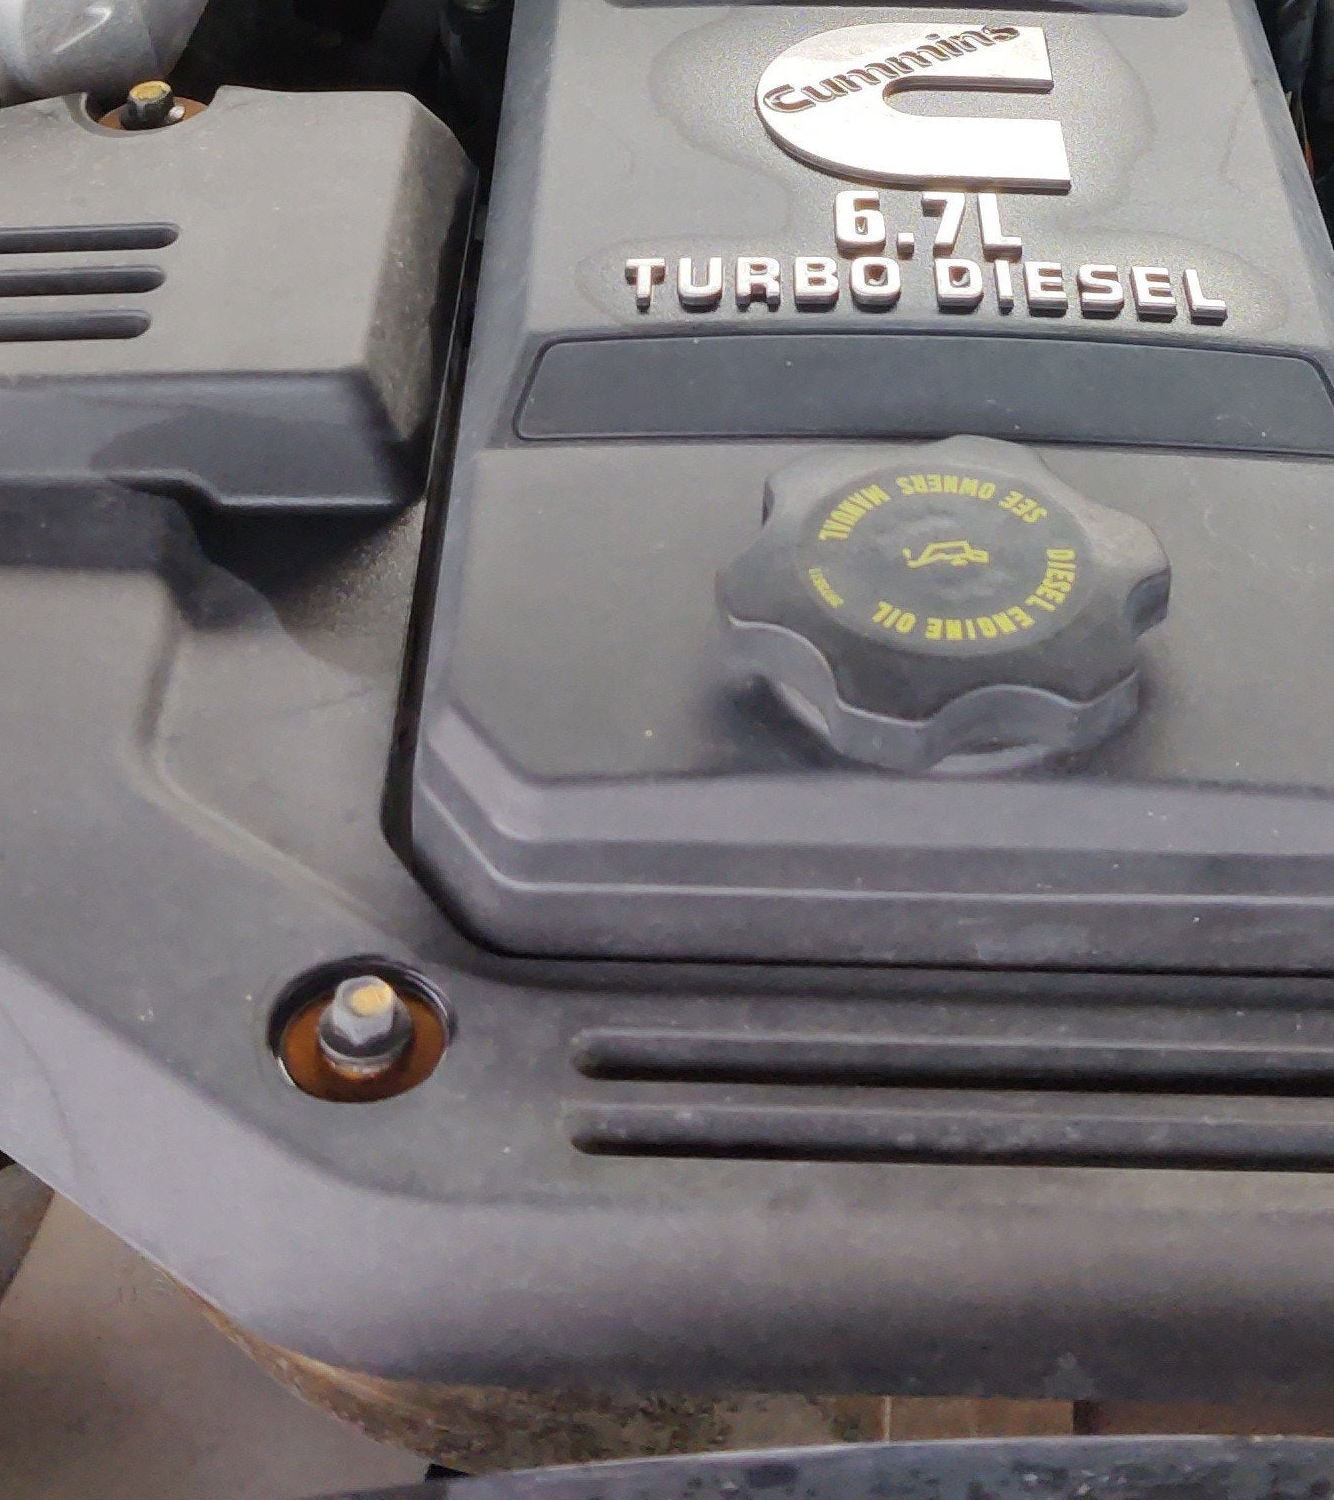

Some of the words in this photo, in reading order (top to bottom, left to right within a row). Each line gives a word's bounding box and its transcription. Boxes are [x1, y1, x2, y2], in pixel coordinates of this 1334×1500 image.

[763, 25, 1020, 113] Cummins
[833, 190, 1022, 259] 6.7L
[625, 256, 901, 313] TURBO
[934, 258, 1227, 323] DIESEL
[818, 484, 892, 541] MANUAL
[895, 474, 997, 500] OWNERS
[998, 490, 1048, 525] SEE
[1024, 548, 1077, 611] DIESEL
[872, 601, 916, 634] OIL
[925, 605, 1035, 640] ENGINE
